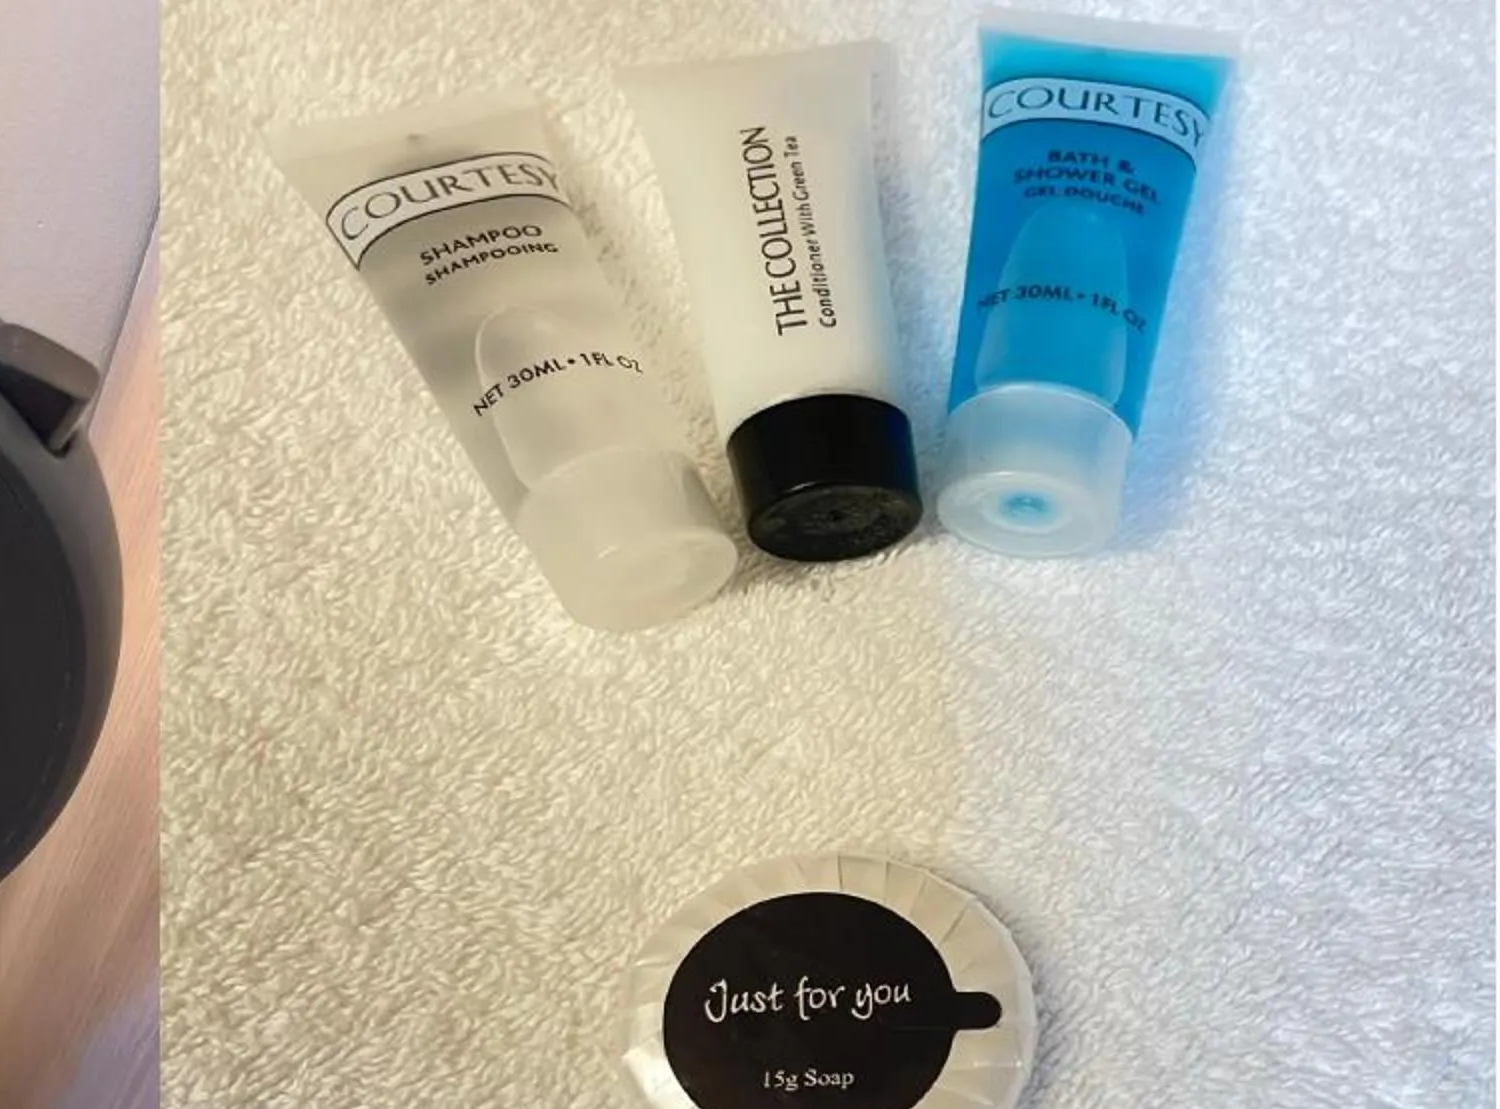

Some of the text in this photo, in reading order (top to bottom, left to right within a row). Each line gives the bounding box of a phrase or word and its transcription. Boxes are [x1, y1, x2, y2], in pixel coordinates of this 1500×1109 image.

[987, 85, 1205, 148] COURTESY
[1013, 166, 1158, 203] SHOWER GEL
[1048, 150, 1135, 175] BATH &
[340, 162, 560, 241] COURTESY
[1024, 185, 1056, 198] GEL
[419, 224, 543, 266] SHAMPOO
[740, 125, 808, 336] THE COLLECTION
[783, 135, 837, 328] Conditioner With Green Tea
[424, 241, 560, 286] SHAMPOOING
[976, 288, 1011, 311] NET
[1014, 284, 1071, 300] 30ML
[472, 383, 505, 417] NET
[507, 360, 566, 389] 30ML
[703, 975, 912, 1023] Just for you
[762, 1067, 855, 1092] 15g Soap
